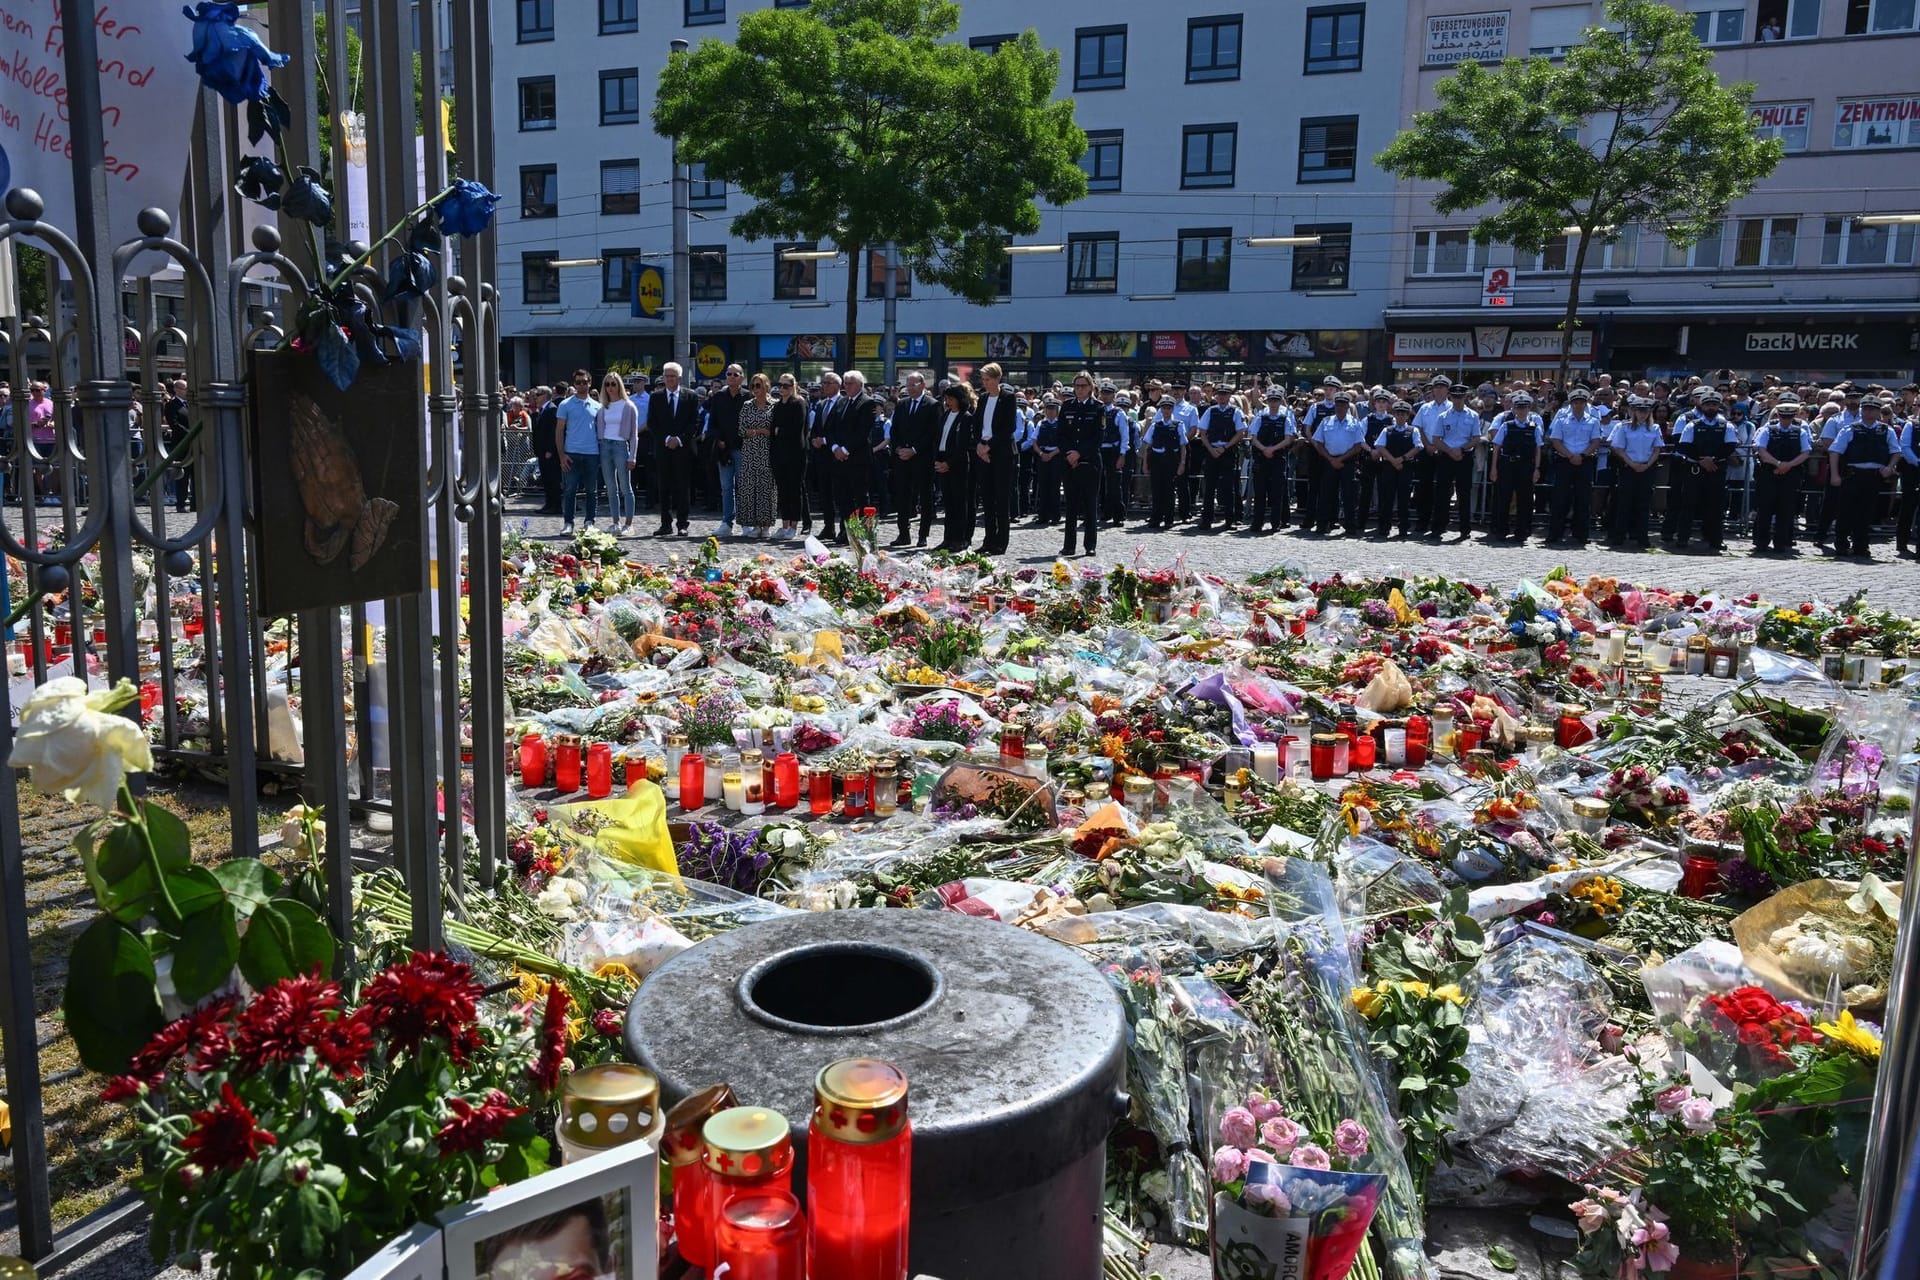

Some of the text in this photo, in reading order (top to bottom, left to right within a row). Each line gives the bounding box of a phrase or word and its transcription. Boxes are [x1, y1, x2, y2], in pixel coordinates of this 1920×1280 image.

[1427, 50, 1504, 62] переводы
[1398, 336, 1591, 349] EINHORN APOTHKE
